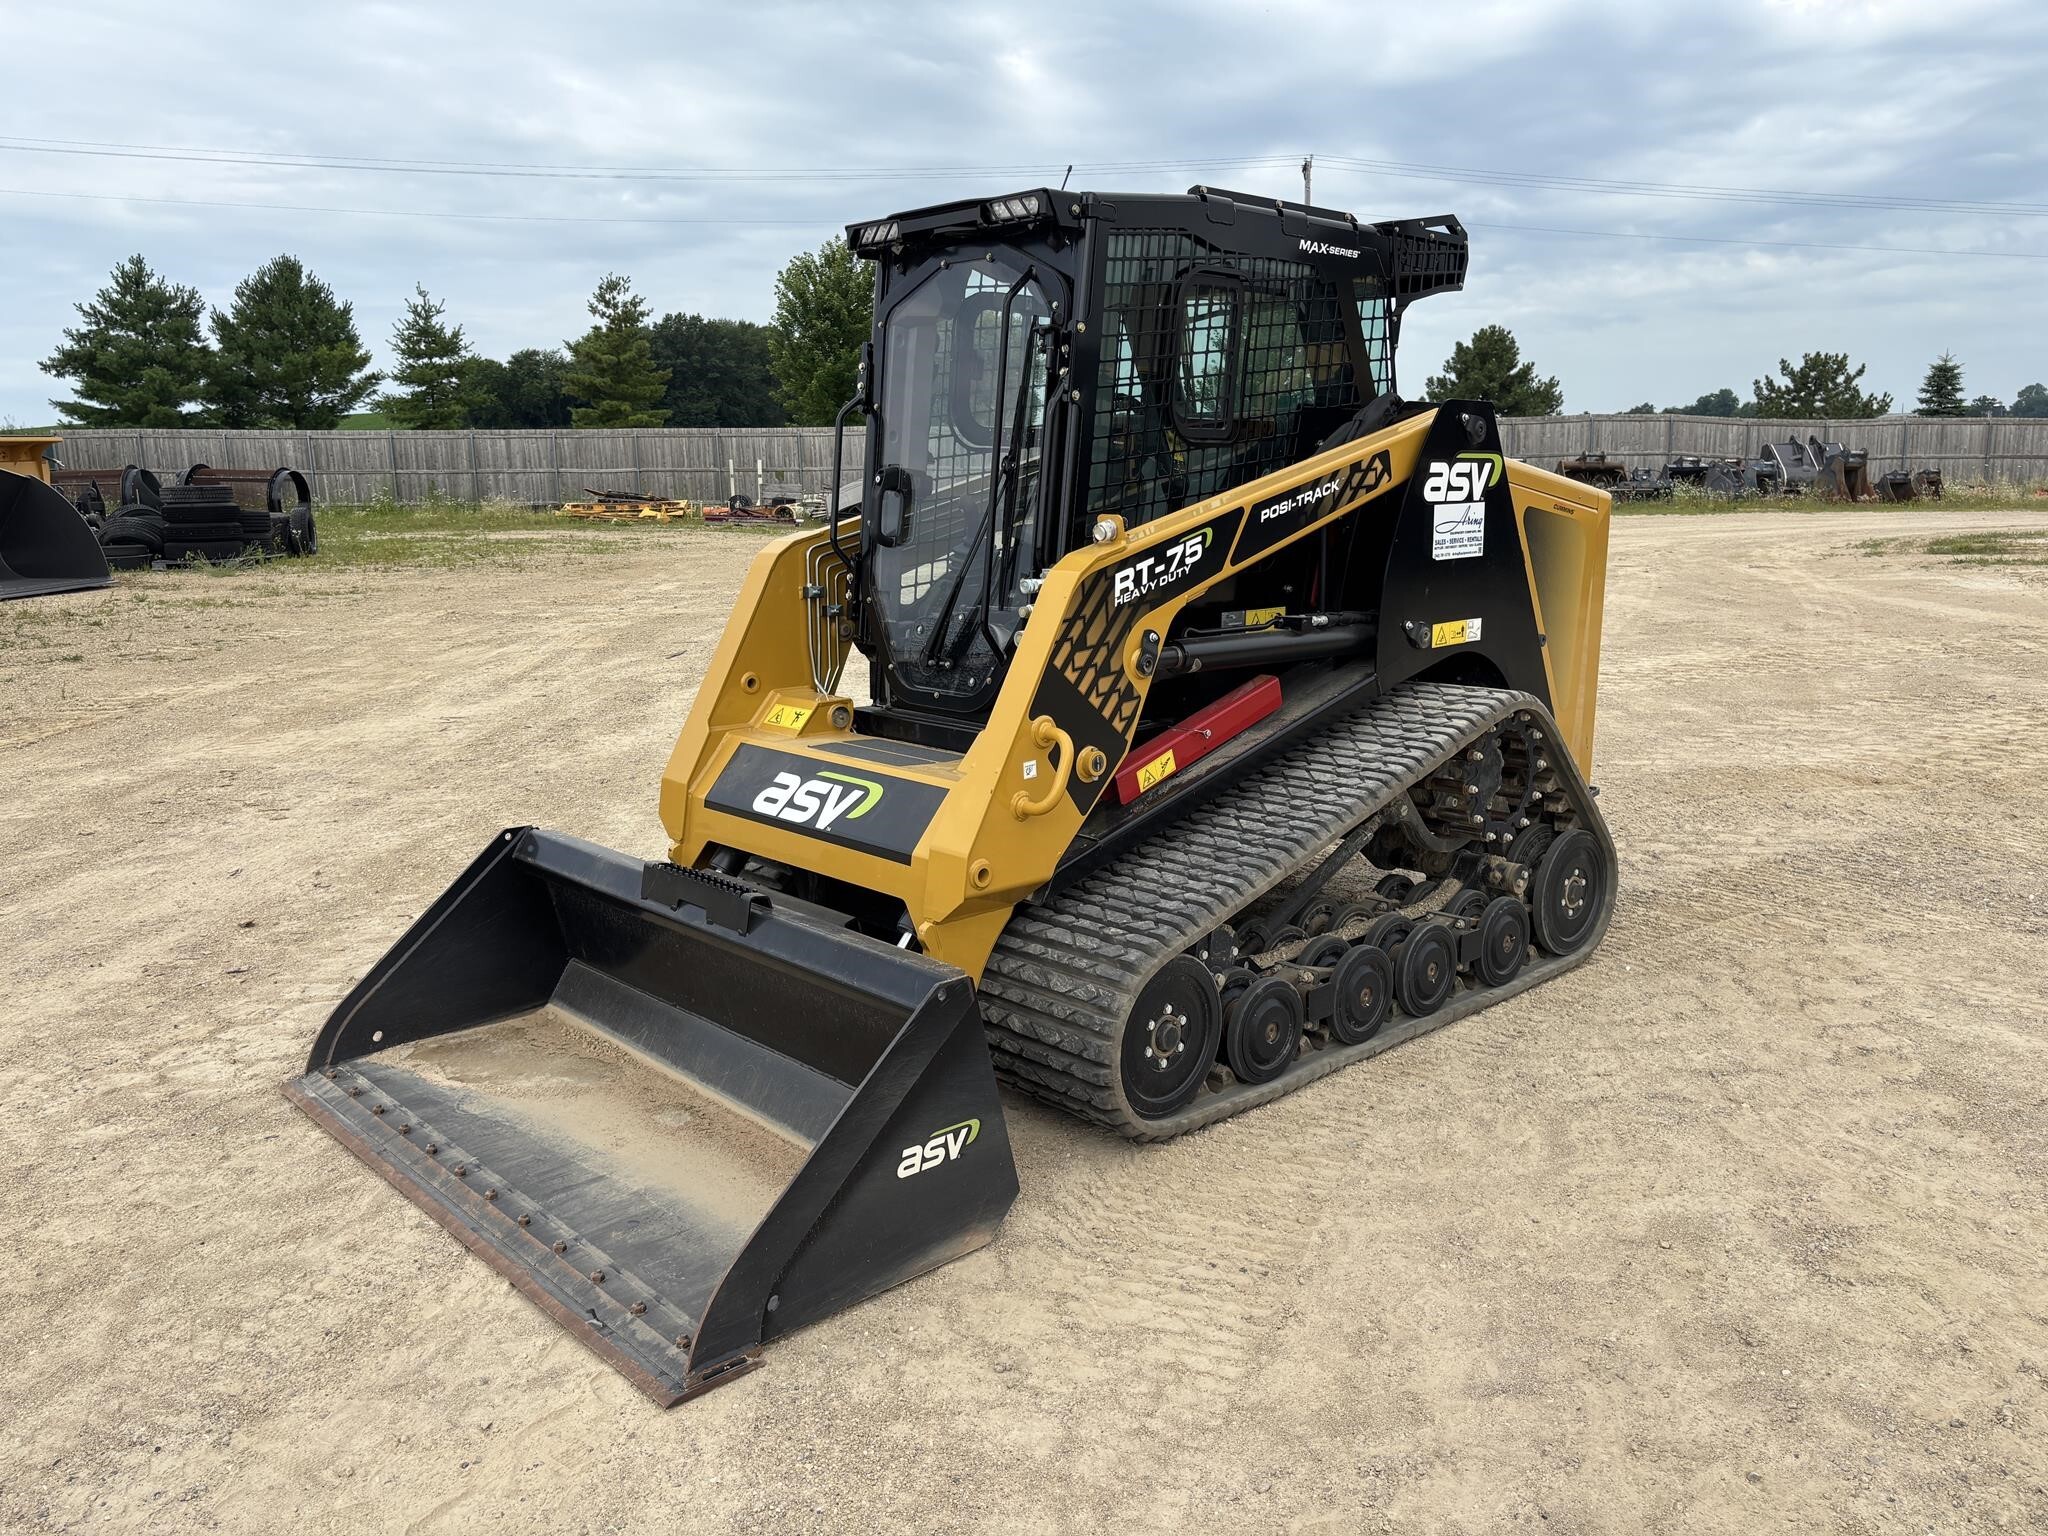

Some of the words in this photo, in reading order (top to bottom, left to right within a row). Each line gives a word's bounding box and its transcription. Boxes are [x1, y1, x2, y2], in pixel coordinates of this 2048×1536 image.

[1260, 478, 1340, 523] POSI-TRACK
[1114, 535, 1203, 598] RT-75
[1114, 579, 1158, 607] HEAVY
[1159, 564, 1192, 587] DUTY
